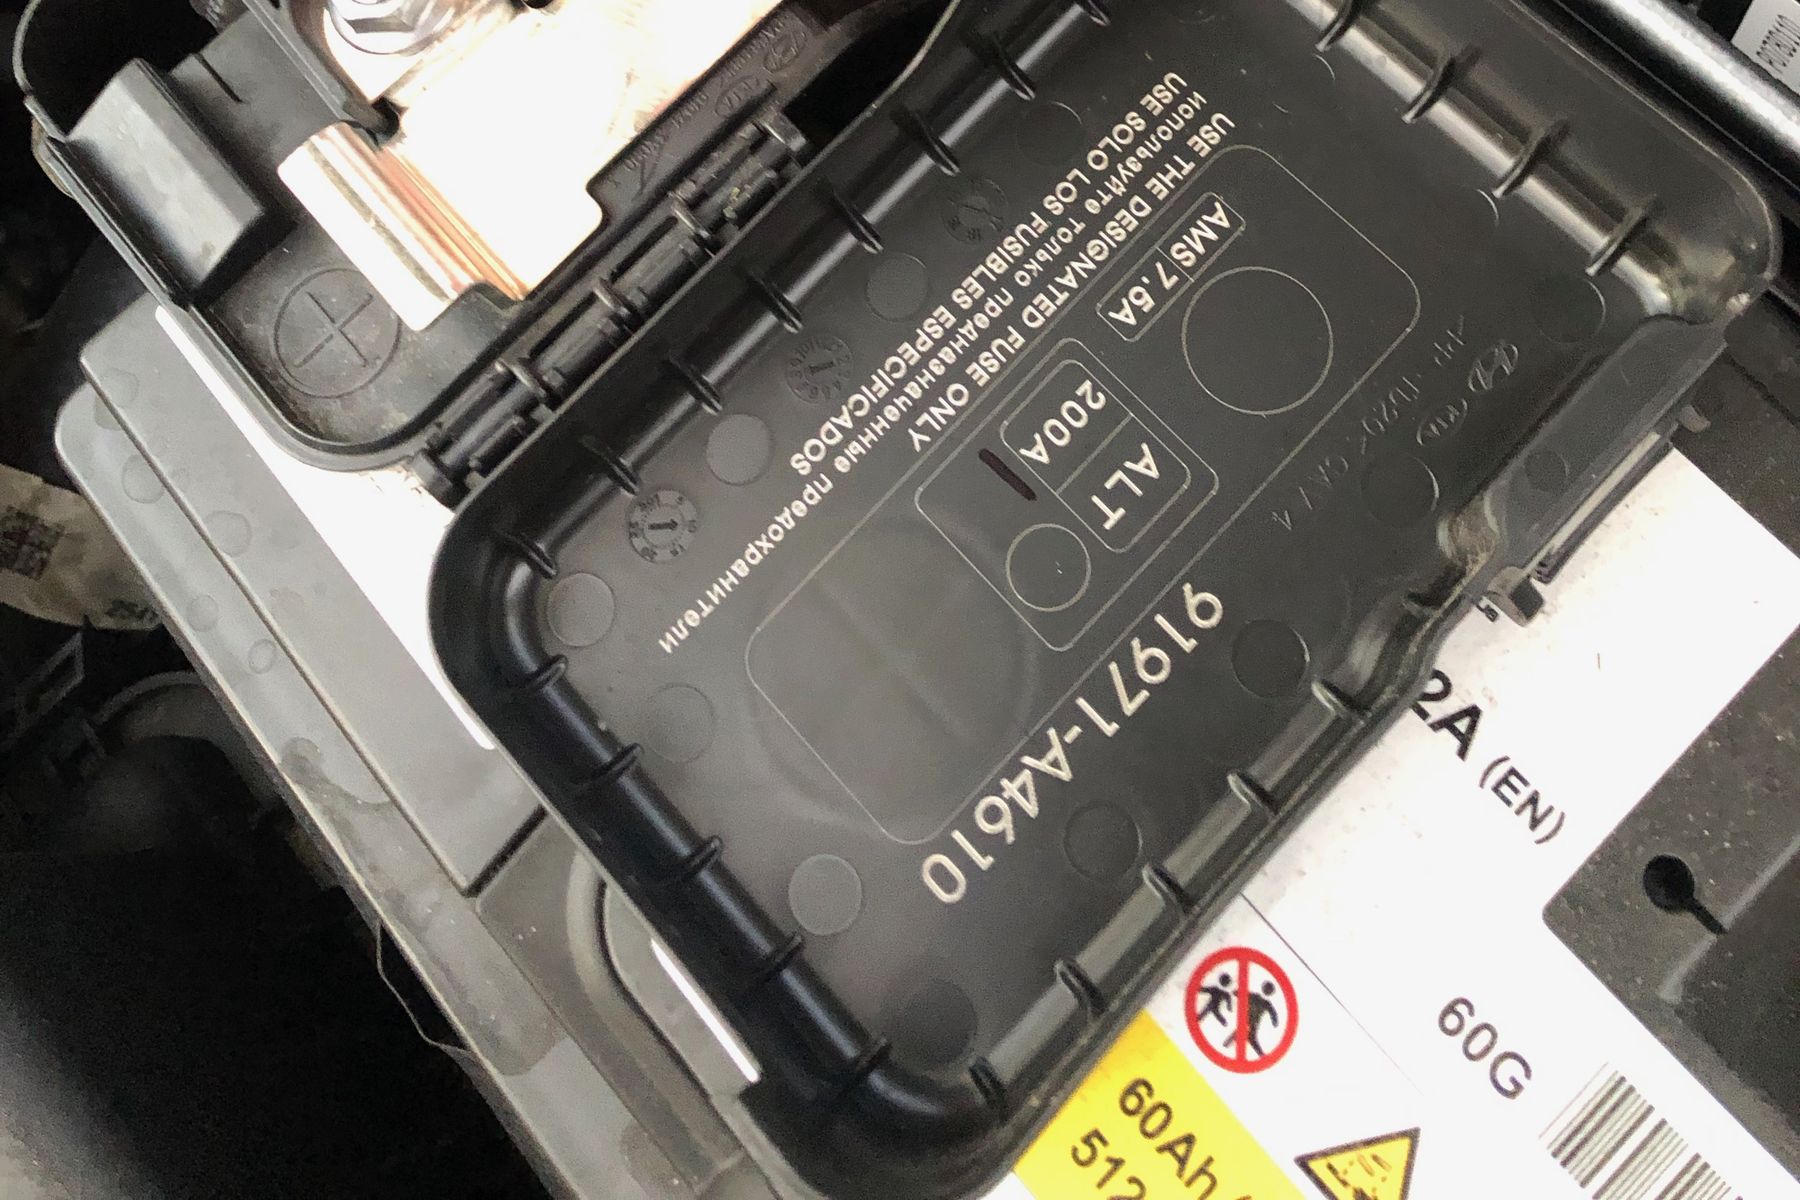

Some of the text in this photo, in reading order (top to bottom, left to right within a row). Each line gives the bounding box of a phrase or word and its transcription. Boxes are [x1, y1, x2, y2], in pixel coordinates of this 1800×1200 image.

[1086, 111, 1147, 171] SOLO
[1139, 71, 1188, 117] USE
[1042, 167, 1092, 216] LOS
[1084, 90, 1208, 215] используйте
[907, 112, 1236, 453] USE THE DESIGNATED FUSE ONLY
[951, 210, 1049, 310] FUSIBLES
[1013, 217, 1087, 287] только
[1107, 201, 1231, 326] AMS 7.5A
[789, 304, 957, 476] ESPECIFICADOS
[833, 287, 1015, 474] предназначенные
[1018, 379, 1107, 465] 200A
[1090, 442, 1161, 531] ALT
[658, 472, 834, 654] предохранители
[921, 581, 1224, 905] 91971-A4610
[1478, 755, 1566, 845] (EN)
[1437, 996, 1532, 1100] 60G
[1118, 1077, 1218, 1200] 60Ah
